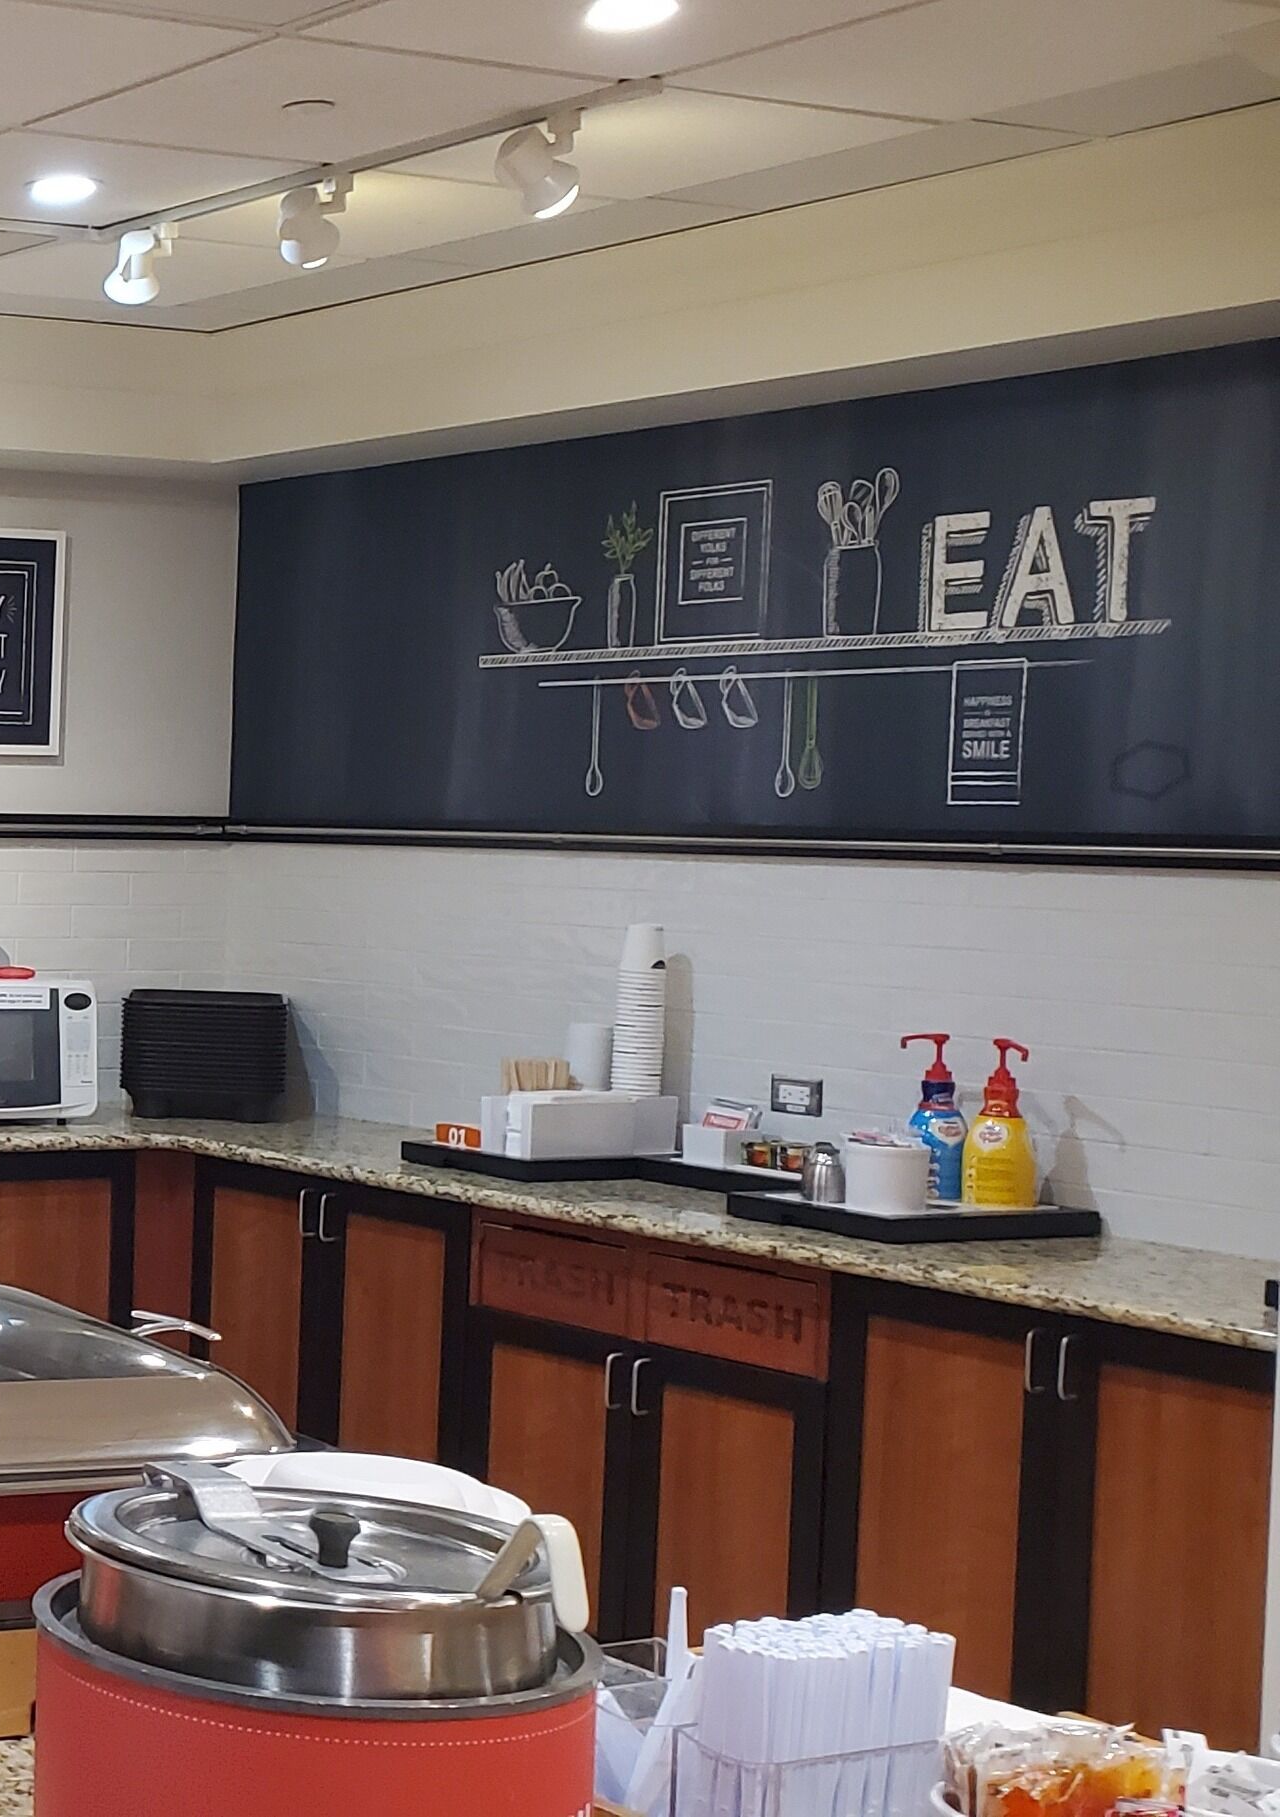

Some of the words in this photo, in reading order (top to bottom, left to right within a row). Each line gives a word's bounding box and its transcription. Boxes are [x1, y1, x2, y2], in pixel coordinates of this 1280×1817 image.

[922, 497, 1156, 640] EAT
[962, 740, 1011, 759] SMILE
[662, 1281, 803, 1345] TRASH
